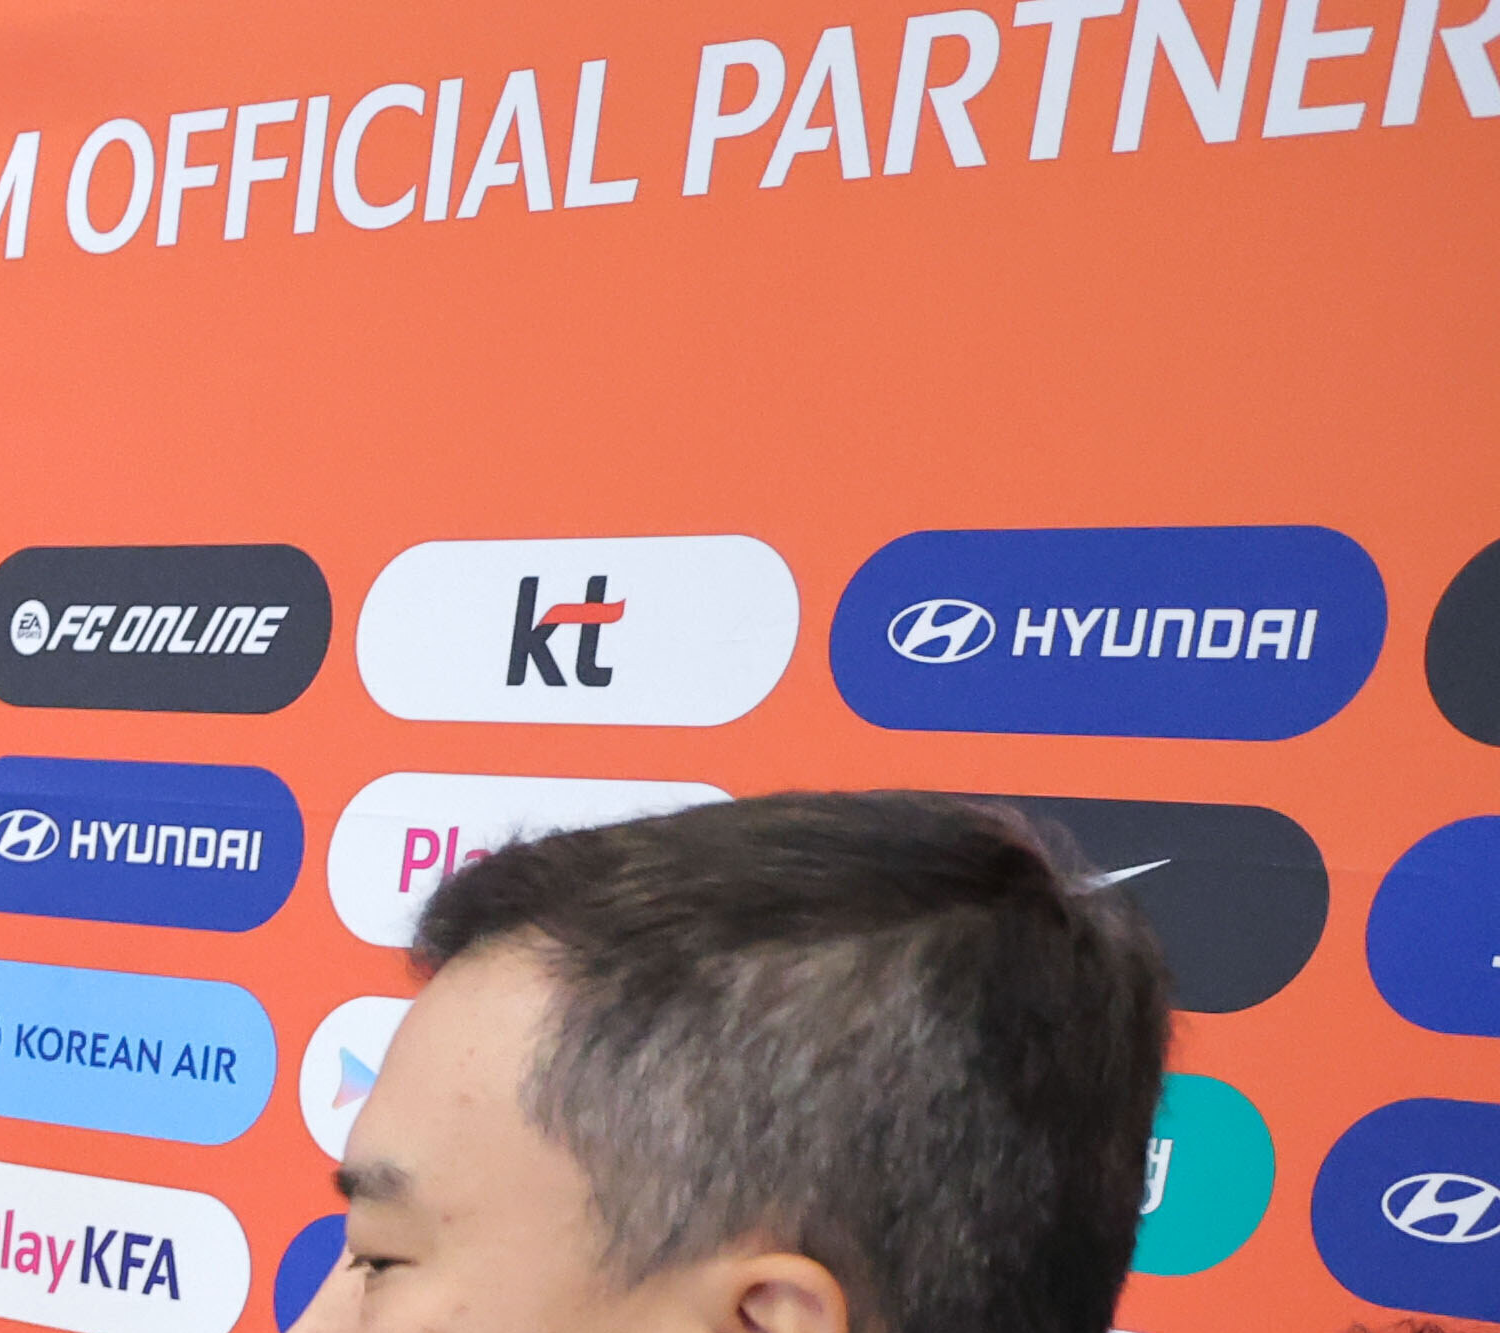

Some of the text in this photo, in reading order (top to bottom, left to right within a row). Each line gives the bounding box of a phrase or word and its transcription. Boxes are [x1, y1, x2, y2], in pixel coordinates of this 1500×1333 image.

[66, 60, 638, 254] OFFICIAL
[46, 606, 289, 653] FC ONLINE
[506, 576, 625, 687] kt
[1012, 608, 1317, 659] HYUNDAI
[70, 820, 261, 870] HYUNDAI
[15, 1024, 236, 1084] KOREAN AIR
